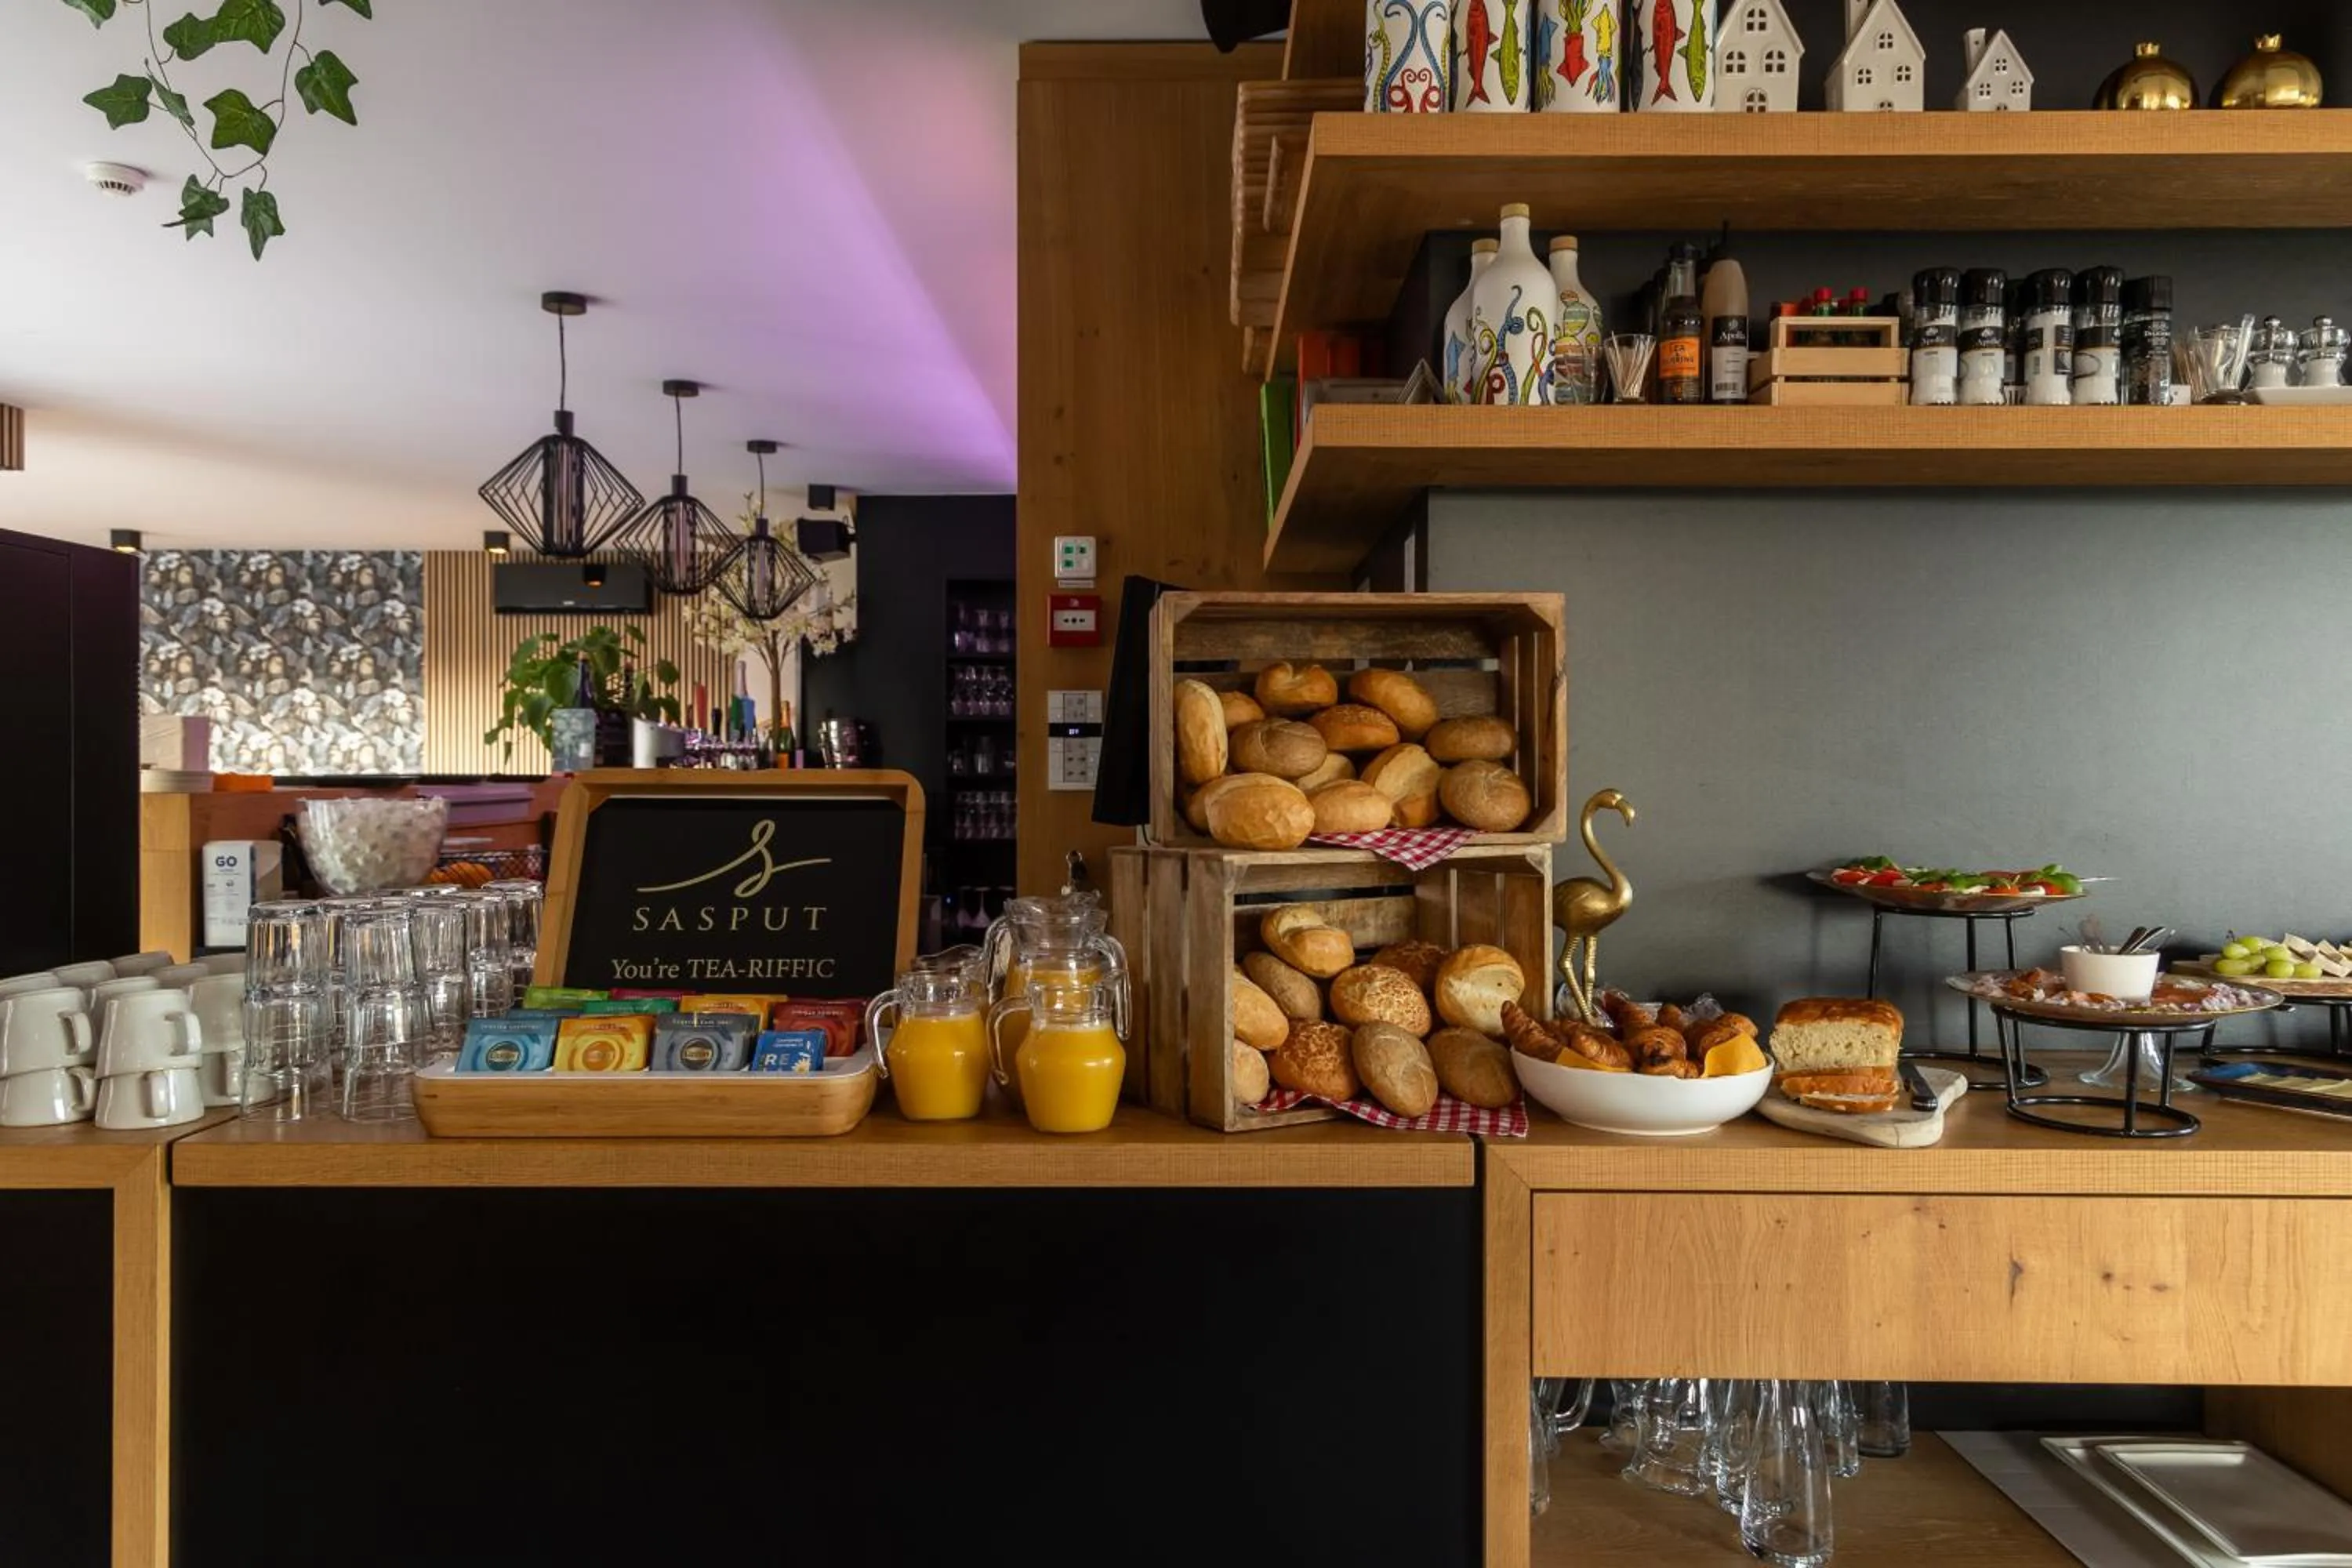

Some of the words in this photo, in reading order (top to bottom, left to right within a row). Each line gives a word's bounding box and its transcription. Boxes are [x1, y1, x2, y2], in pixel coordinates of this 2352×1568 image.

[216, 855, 238, 867] GO
[633, 906, 827, 931] SASPUT
[612, 957, 681, 979] You're
[686, 959, 836, 978] TEA-RIFFIC
